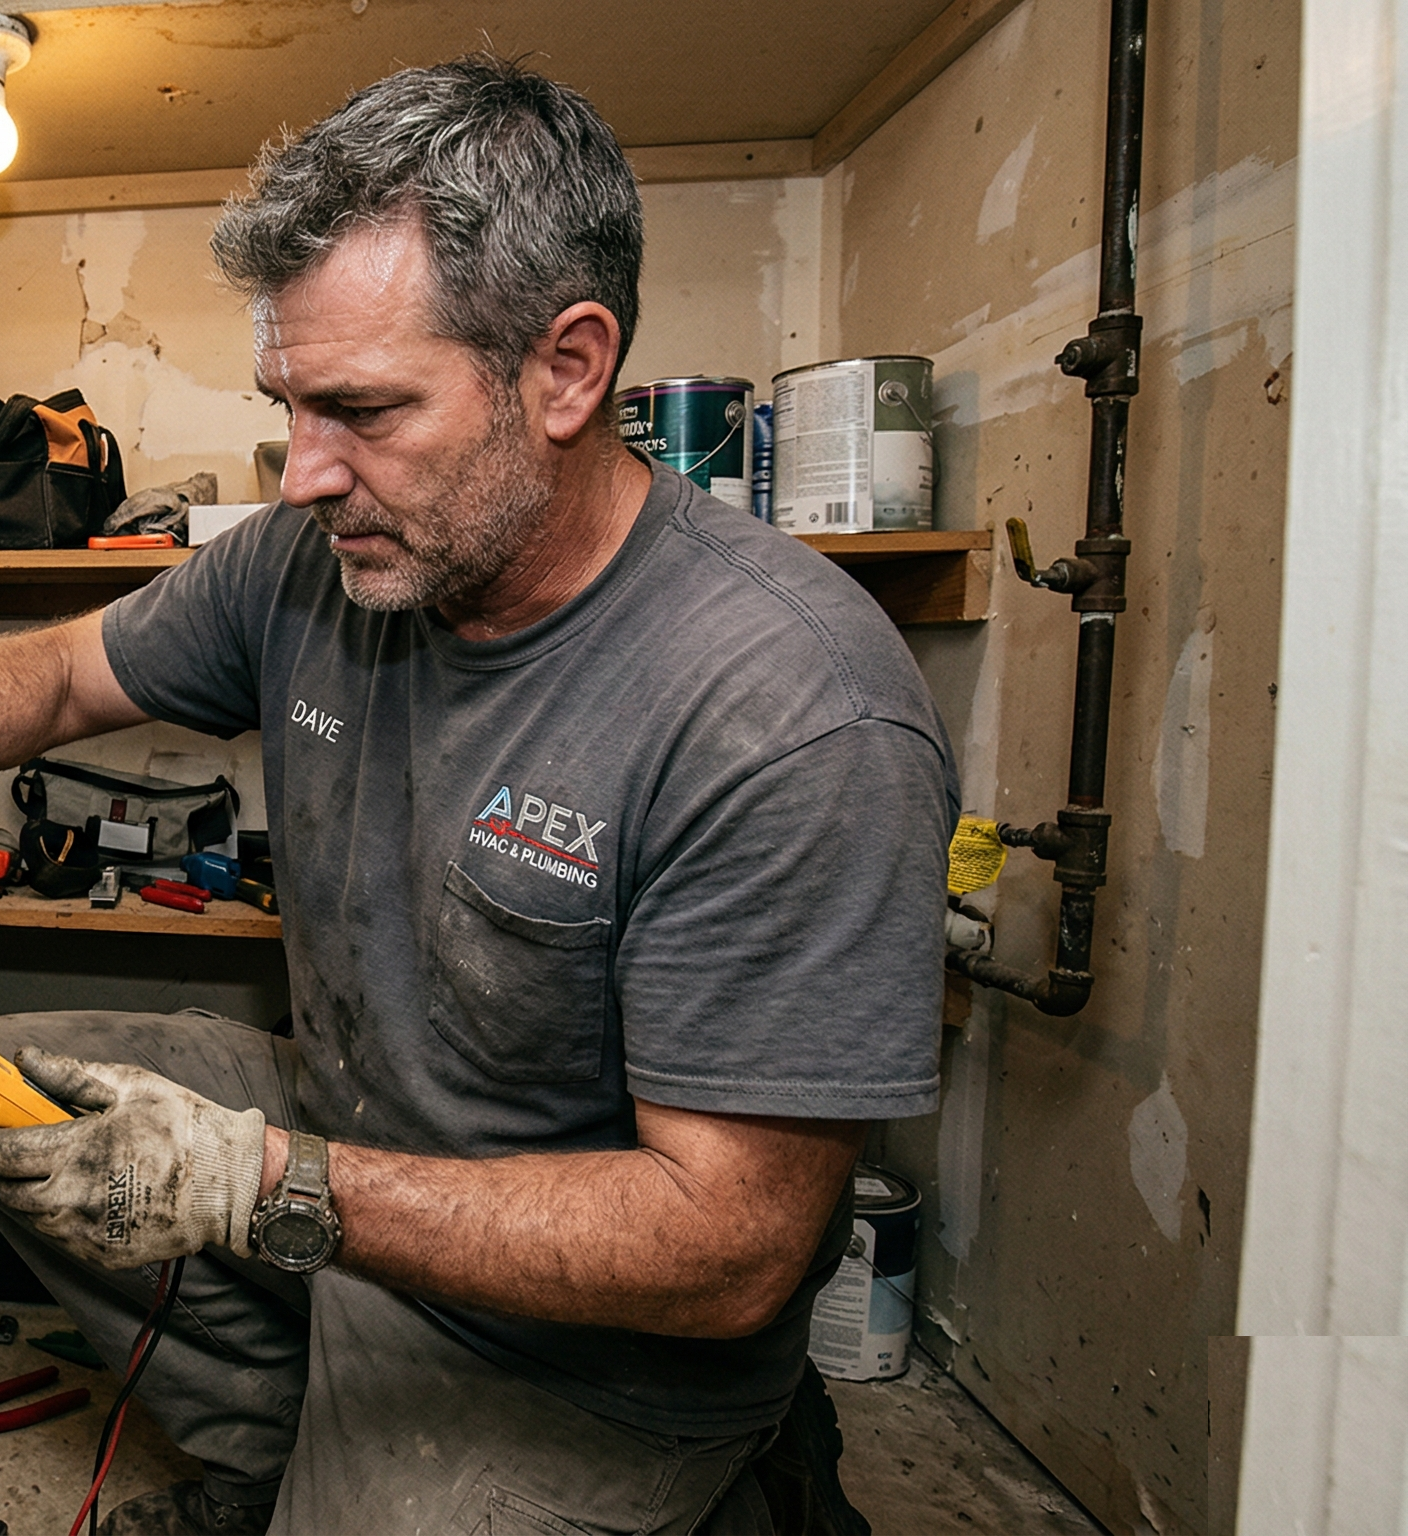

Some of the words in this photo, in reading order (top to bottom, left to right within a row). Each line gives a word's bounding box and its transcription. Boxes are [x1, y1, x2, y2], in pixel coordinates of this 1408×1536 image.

[290, 699, 345, 744] DAVE
[474, 785, 608, 863] APEX
[468, 827, 509, 854] HVAC
[509, 843, 519, 859] &
[520, 847, 598, 889] PLUMBING
